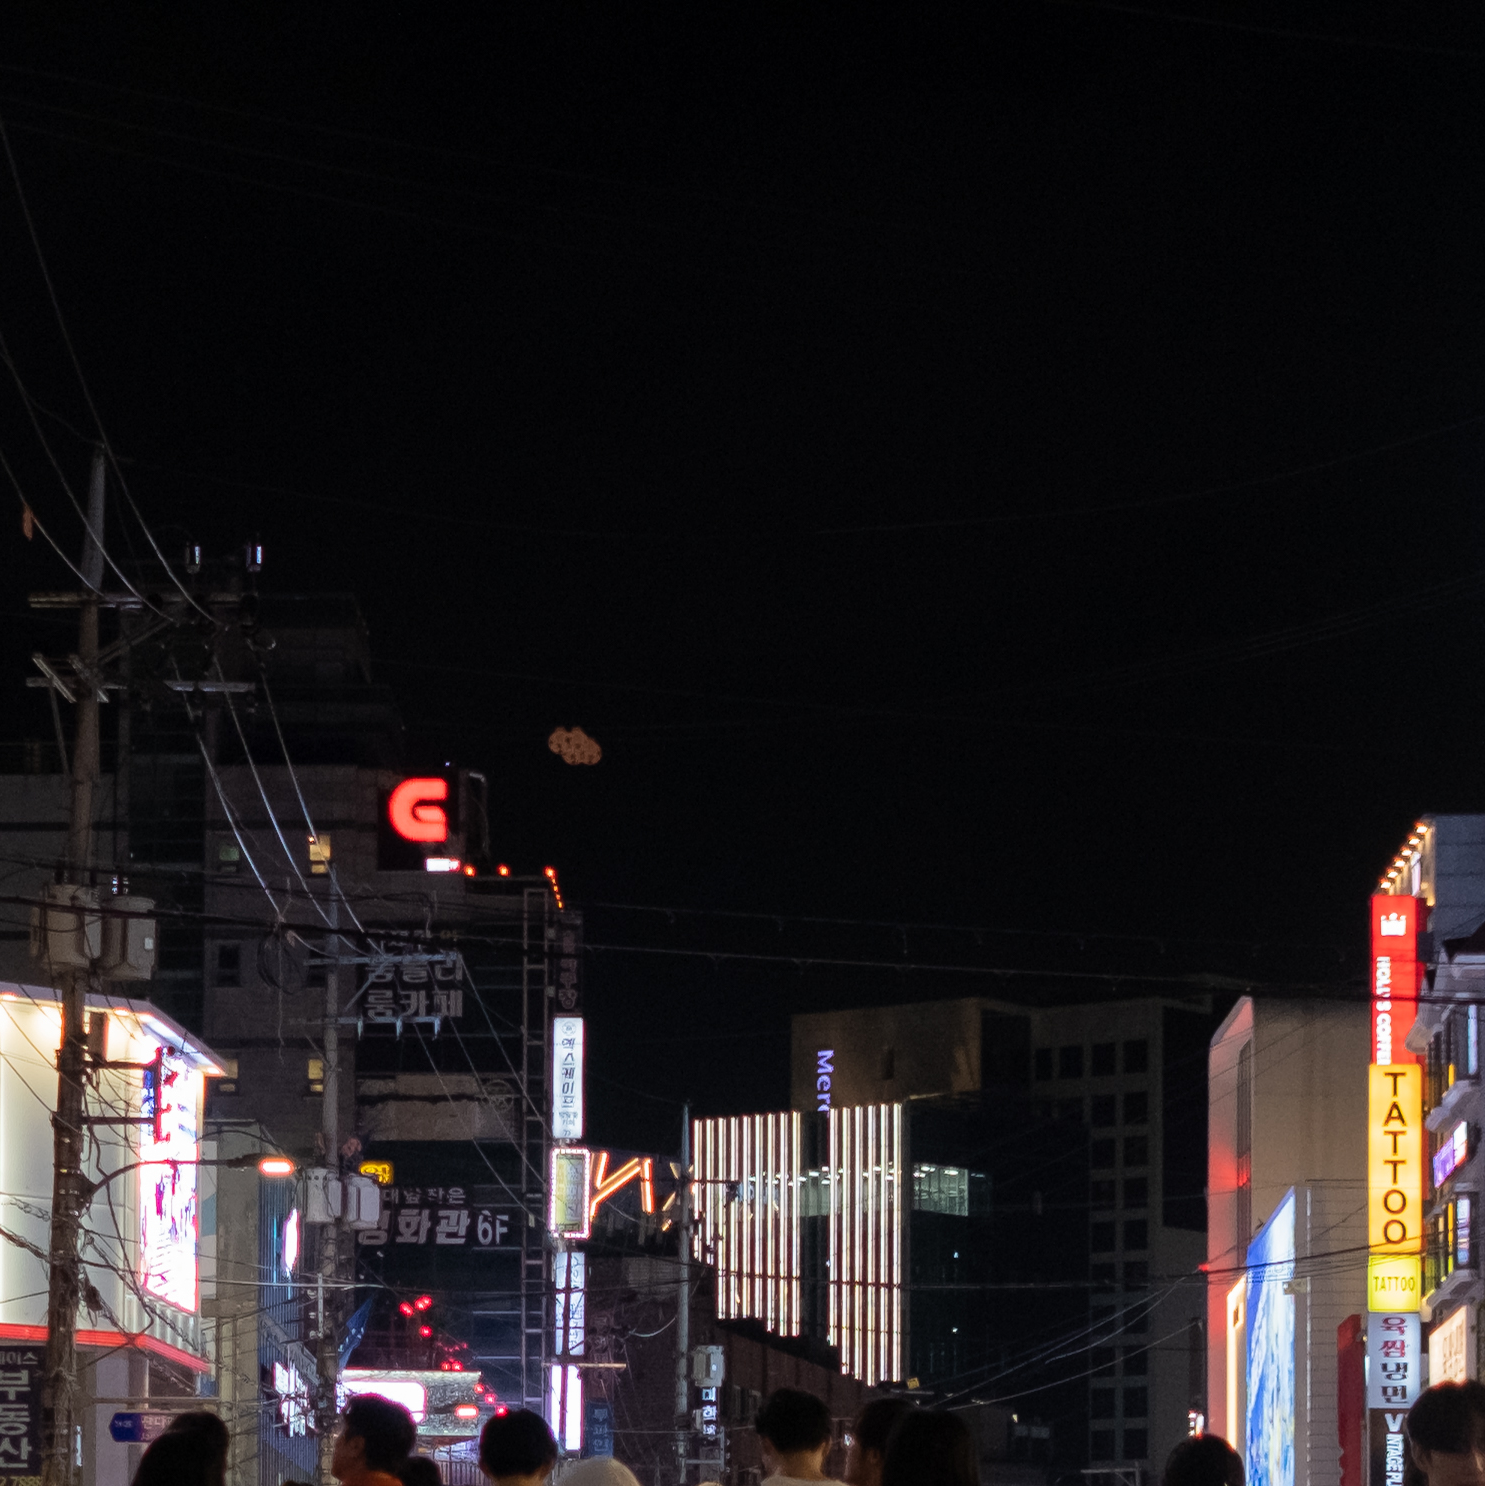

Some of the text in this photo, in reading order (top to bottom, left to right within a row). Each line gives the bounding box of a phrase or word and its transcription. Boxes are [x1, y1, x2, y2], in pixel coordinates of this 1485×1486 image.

[364, 989, 463, 1019] 룸카페
[1384, 1072, 1407, 1245] TATTOO
[1373, 1276, 1416, 1293] TATTOO
[1380, 1316, 1409, 1404] 육쌈냉면
